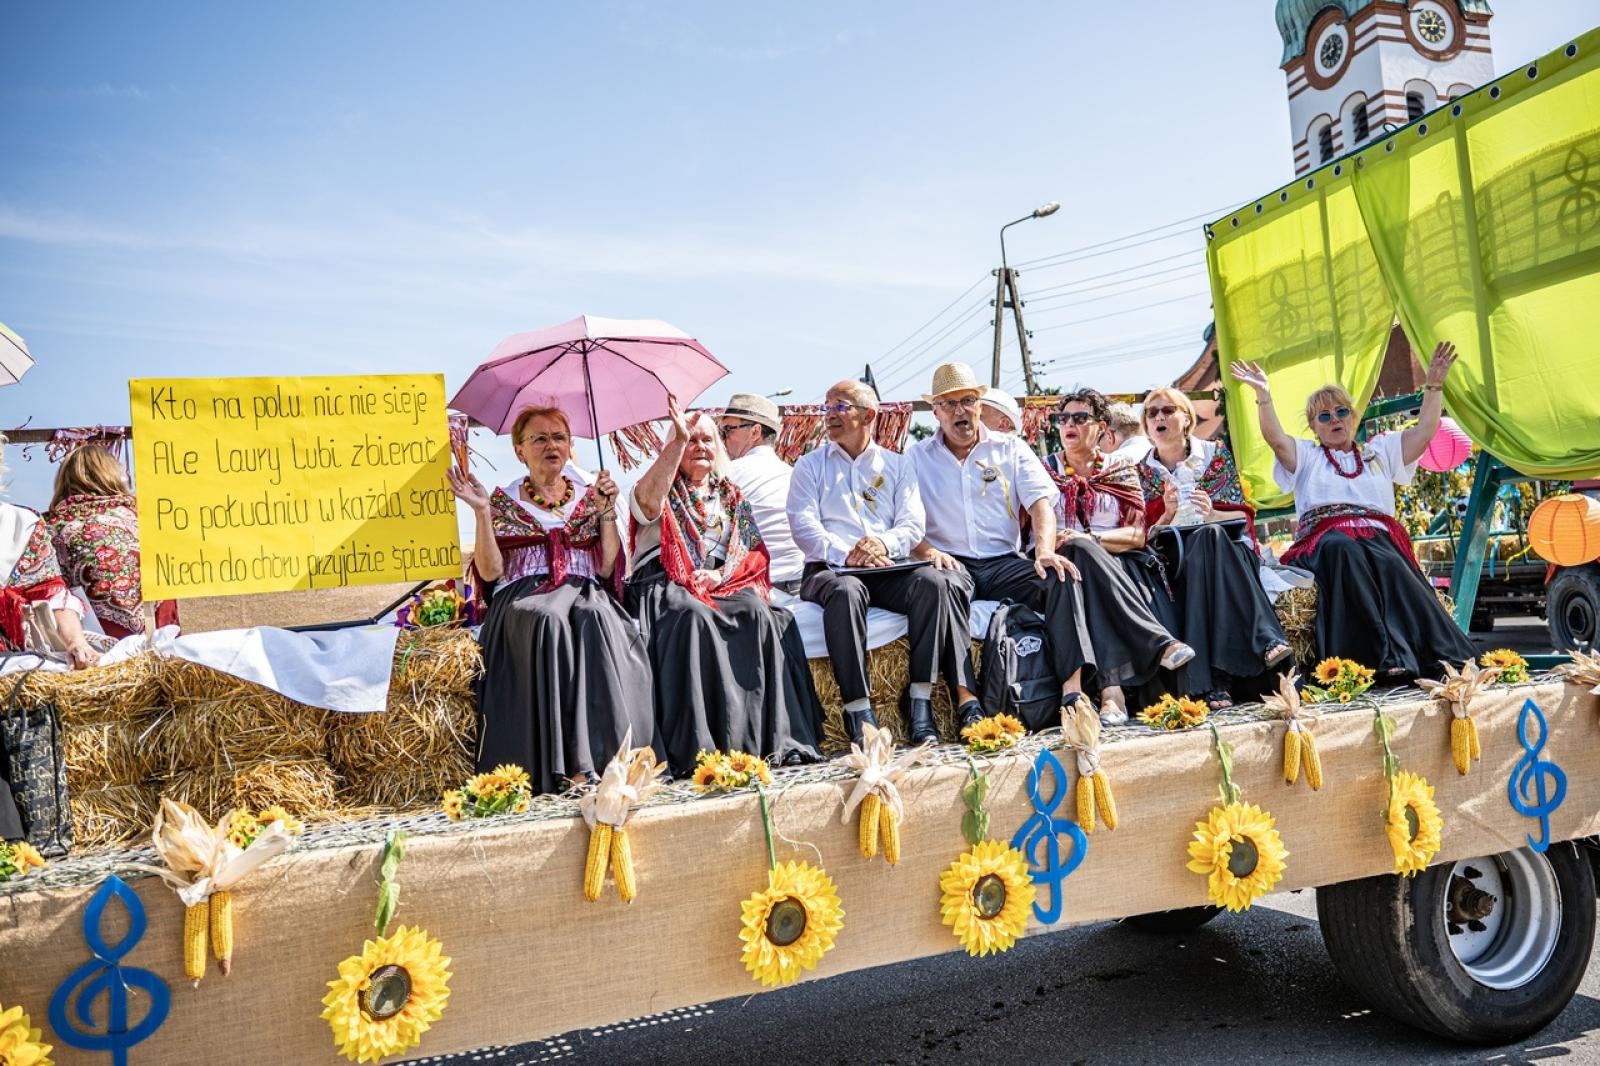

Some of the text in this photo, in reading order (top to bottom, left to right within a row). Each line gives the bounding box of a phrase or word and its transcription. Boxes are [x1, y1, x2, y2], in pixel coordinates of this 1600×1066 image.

[150, 384, 428, 431] Kto na polu nic nie sieje
[153, 440, 199, 475] Ale
[291, 435, 342, 470] lubi
[351, 433, 437, 467] zbierać
[156, 498, 189, 531] Po
[200, 490, 309, 542] południu
[318, 498, 335, 522] w
[339, 479, 406, 521] każdą
[156, 539, 461, 589] Niech do chóru przyjdzie śpiewać
